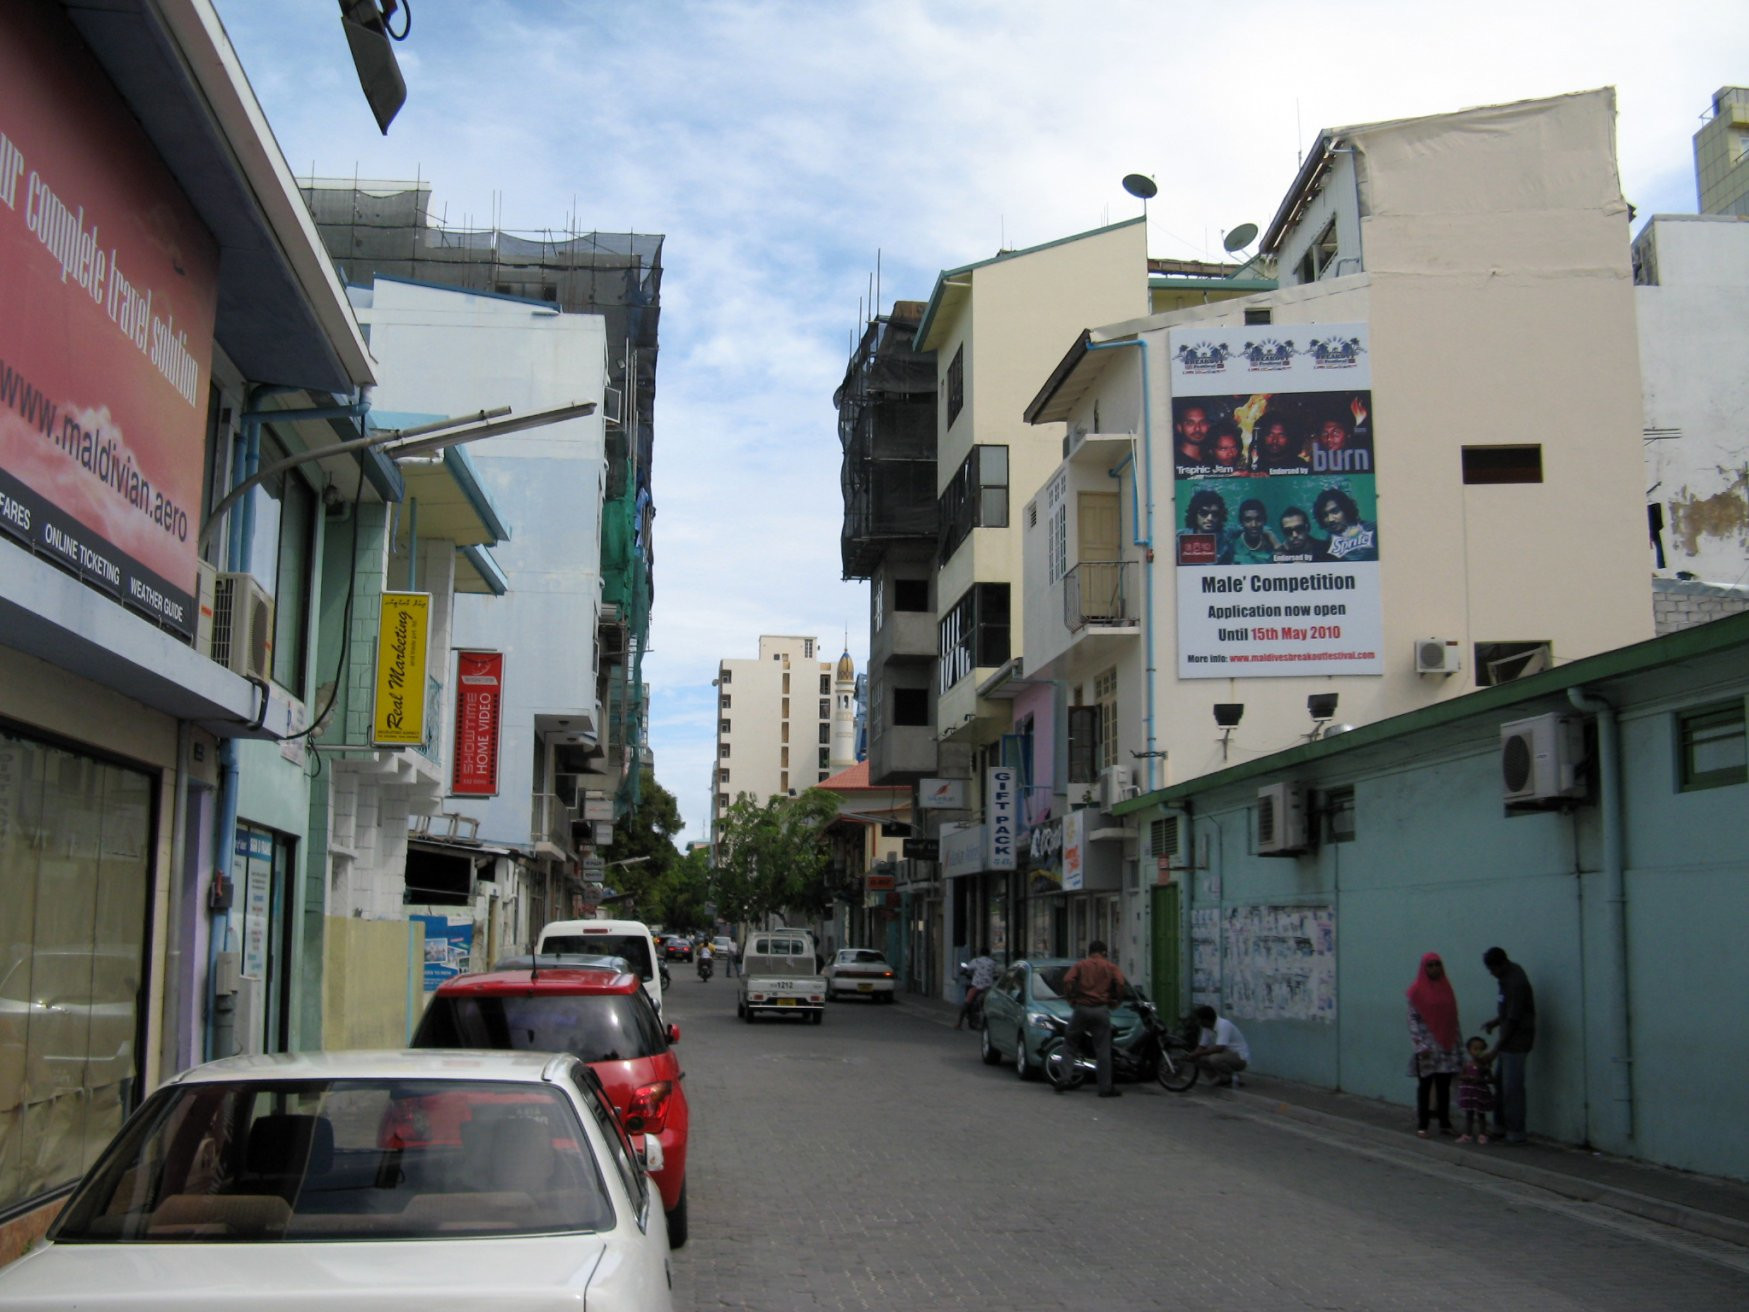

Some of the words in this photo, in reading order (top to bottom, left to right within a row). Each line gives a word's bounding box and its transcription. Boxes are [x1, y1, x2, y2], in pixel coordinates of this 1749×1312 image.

[26, 169, 105, 305] complete
[107, 248, 152, 355] travel
[151, 315, 199, 408] solution
[0, 358, 188, 543] www.maldivian.aero
[1311, 441, 1369, 472] burn
[1175, 465, 1210, 476] Traphic
[1212, 464, 1233, 474] Jam
[1299, 466, 1308, 475] by
[1273, 554, 1301, 562] Endorsed
[1302, 553, 1312, 562] by
[1334, 533, 1372, 553] Sprite
[44, 522, 79, 561] ONLINE
[79, 544, 121, 586] TICKETING
[129, 576, 163, 611] WEATHER
[163, 597, 184, 623] GUIDE
[1201, 576, 1246, 593] Male'
[1250, 573, 1355, 593] Competition
[1208, 604, 1281, 620] Application
[1284, 605, 1310, 617] now
[1314, 603, 1345, 617] open
[388, 610, 412, 690] Marketing
[1218, 628, 1248, 641] Until
[1250, 626, 1278, 641] 15th
[1281, 626, 1306, 641] May
[1309, 625, 1341, 640] 2010
[1187, 654, 1208, 663] More
[1210, 653, 1228, 663] info:
[387, 692, 404, 731] Real
[478, 692, 491, 732] VIDEO
[463, 692, 478, 774] SHOWTIME
[476, 735, 489, 774] HOME
[994, 772, 1010, 810] GIFT
[994, 816, 1010, 855] PACK
